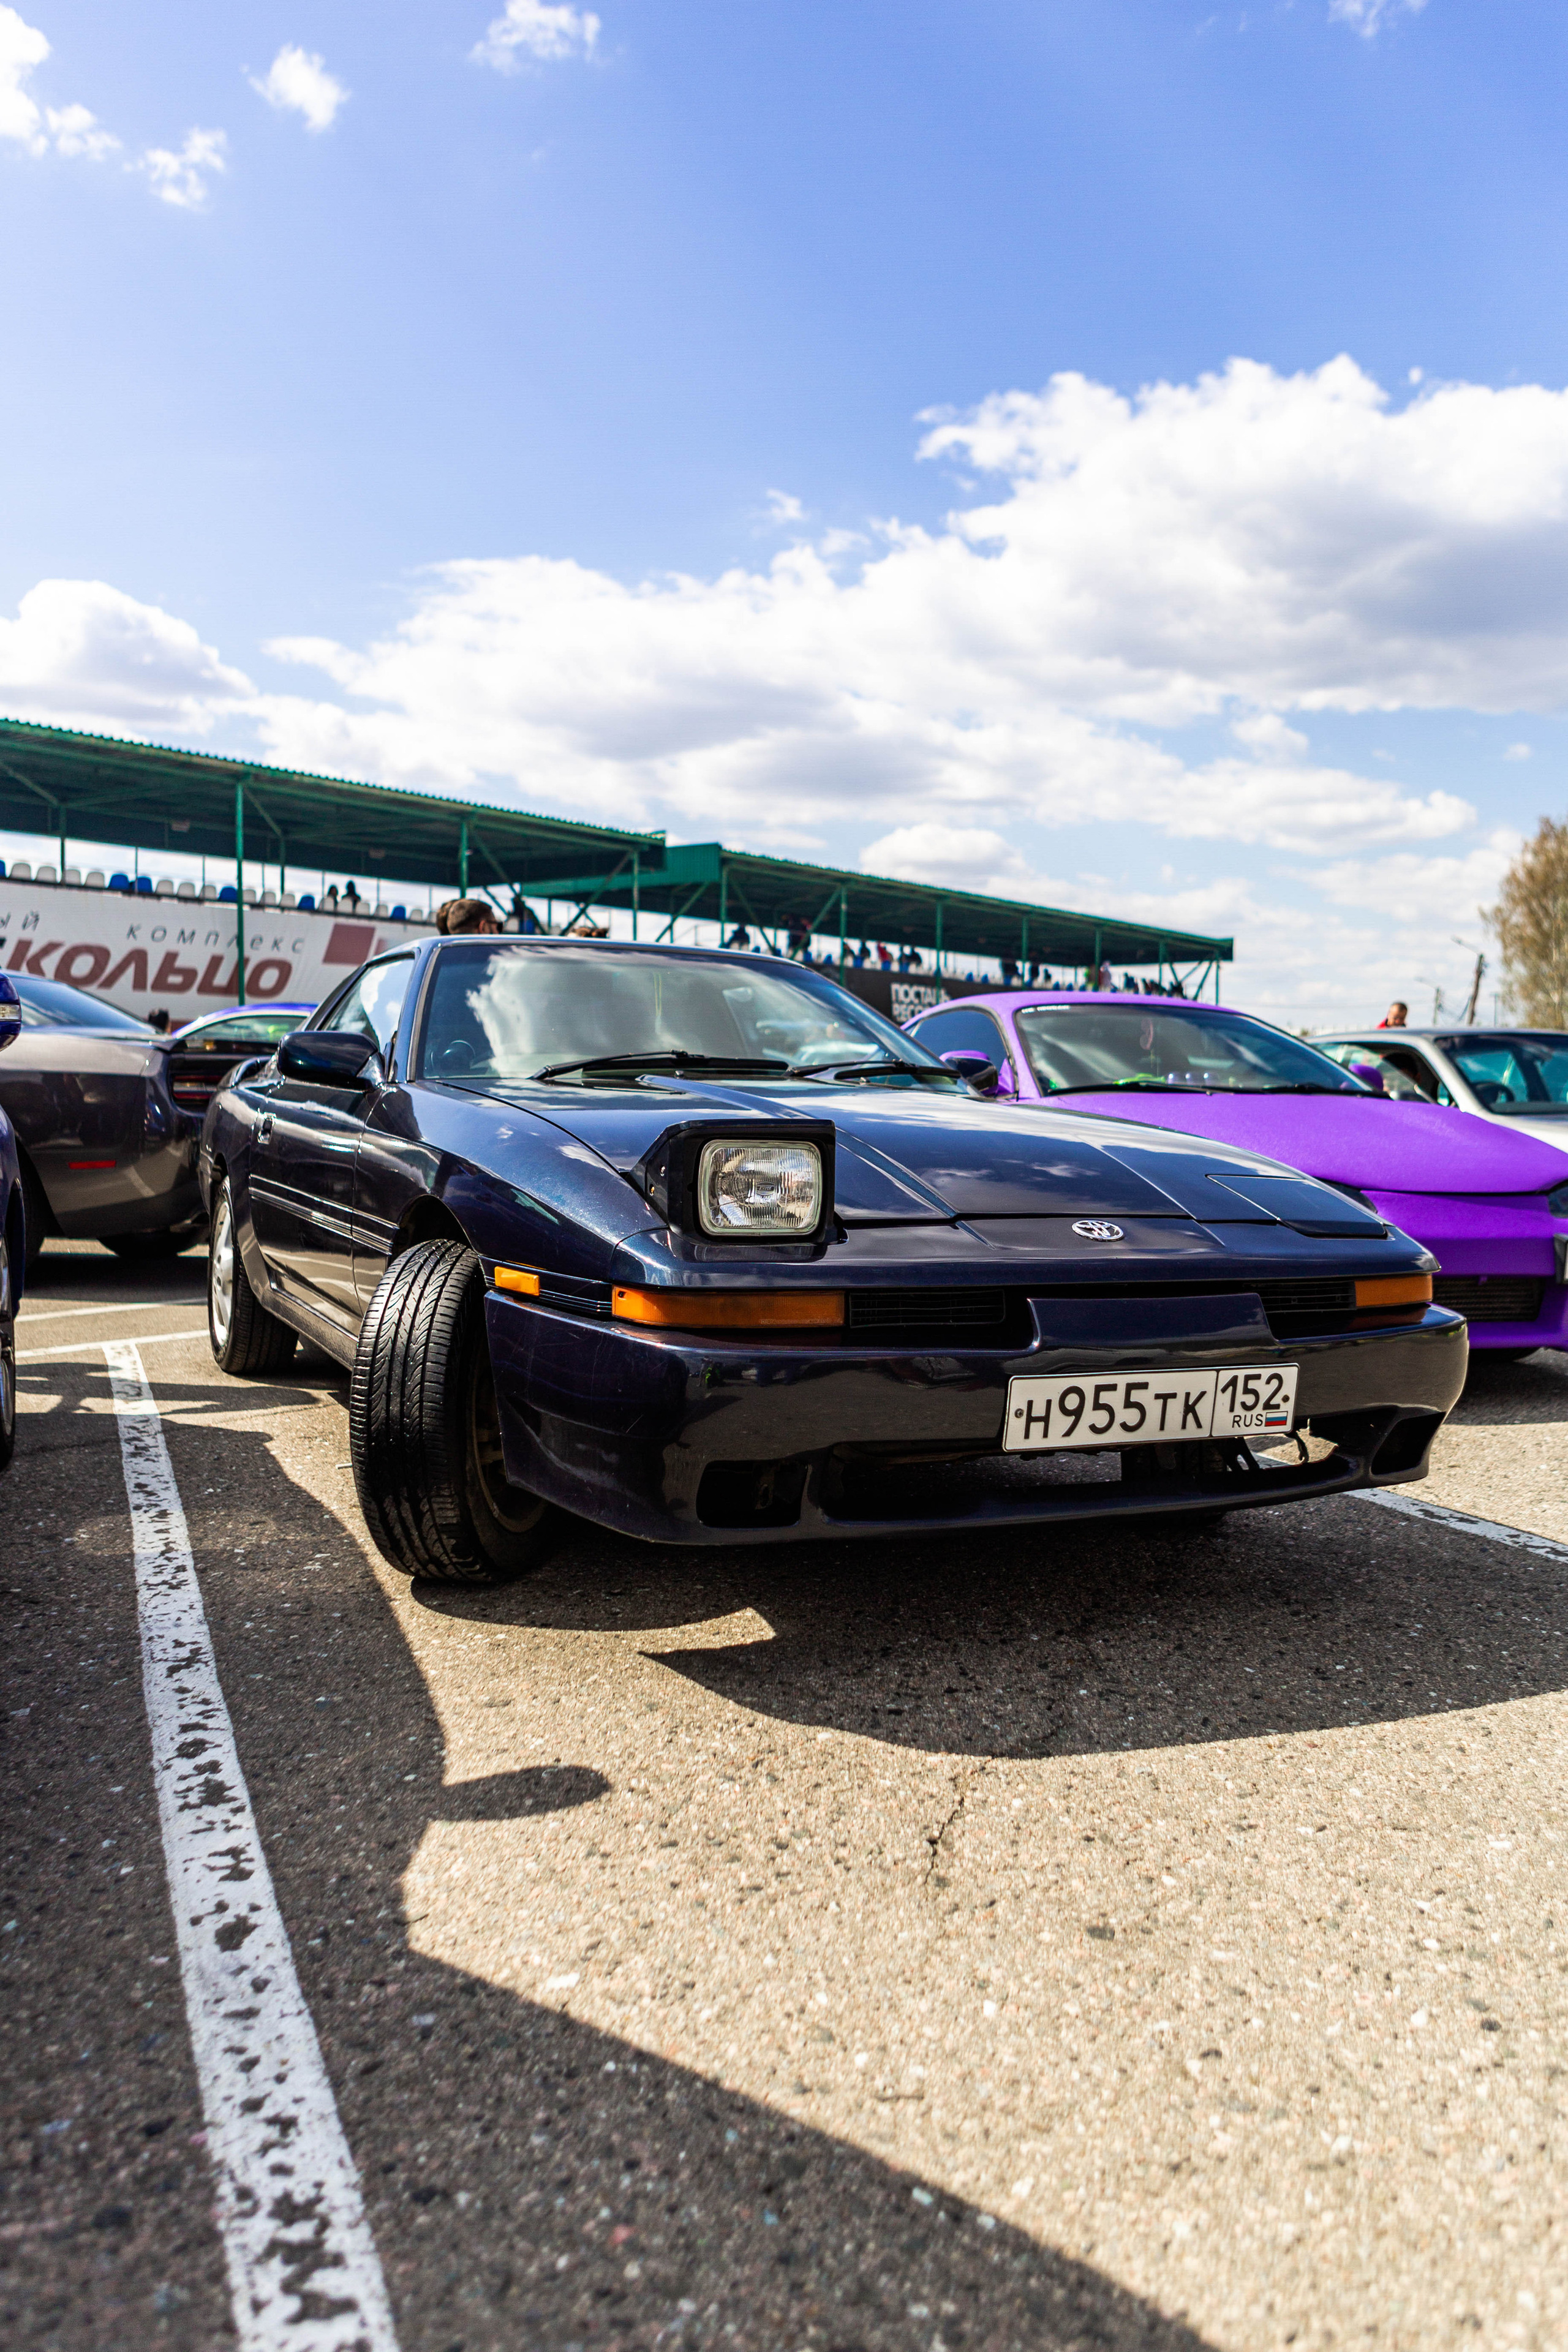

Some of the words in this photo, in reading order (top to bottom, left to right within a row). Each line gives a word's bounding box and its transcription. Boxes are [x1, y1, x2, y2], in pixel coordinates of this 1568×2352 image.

[126, 923, 304, 953] комплекс
[5, 939, 293, 999] КОЛЬЦО
[1220, 1372, 1284, 1413] 152
[1232, 1413, 1264, 1428] RUS
